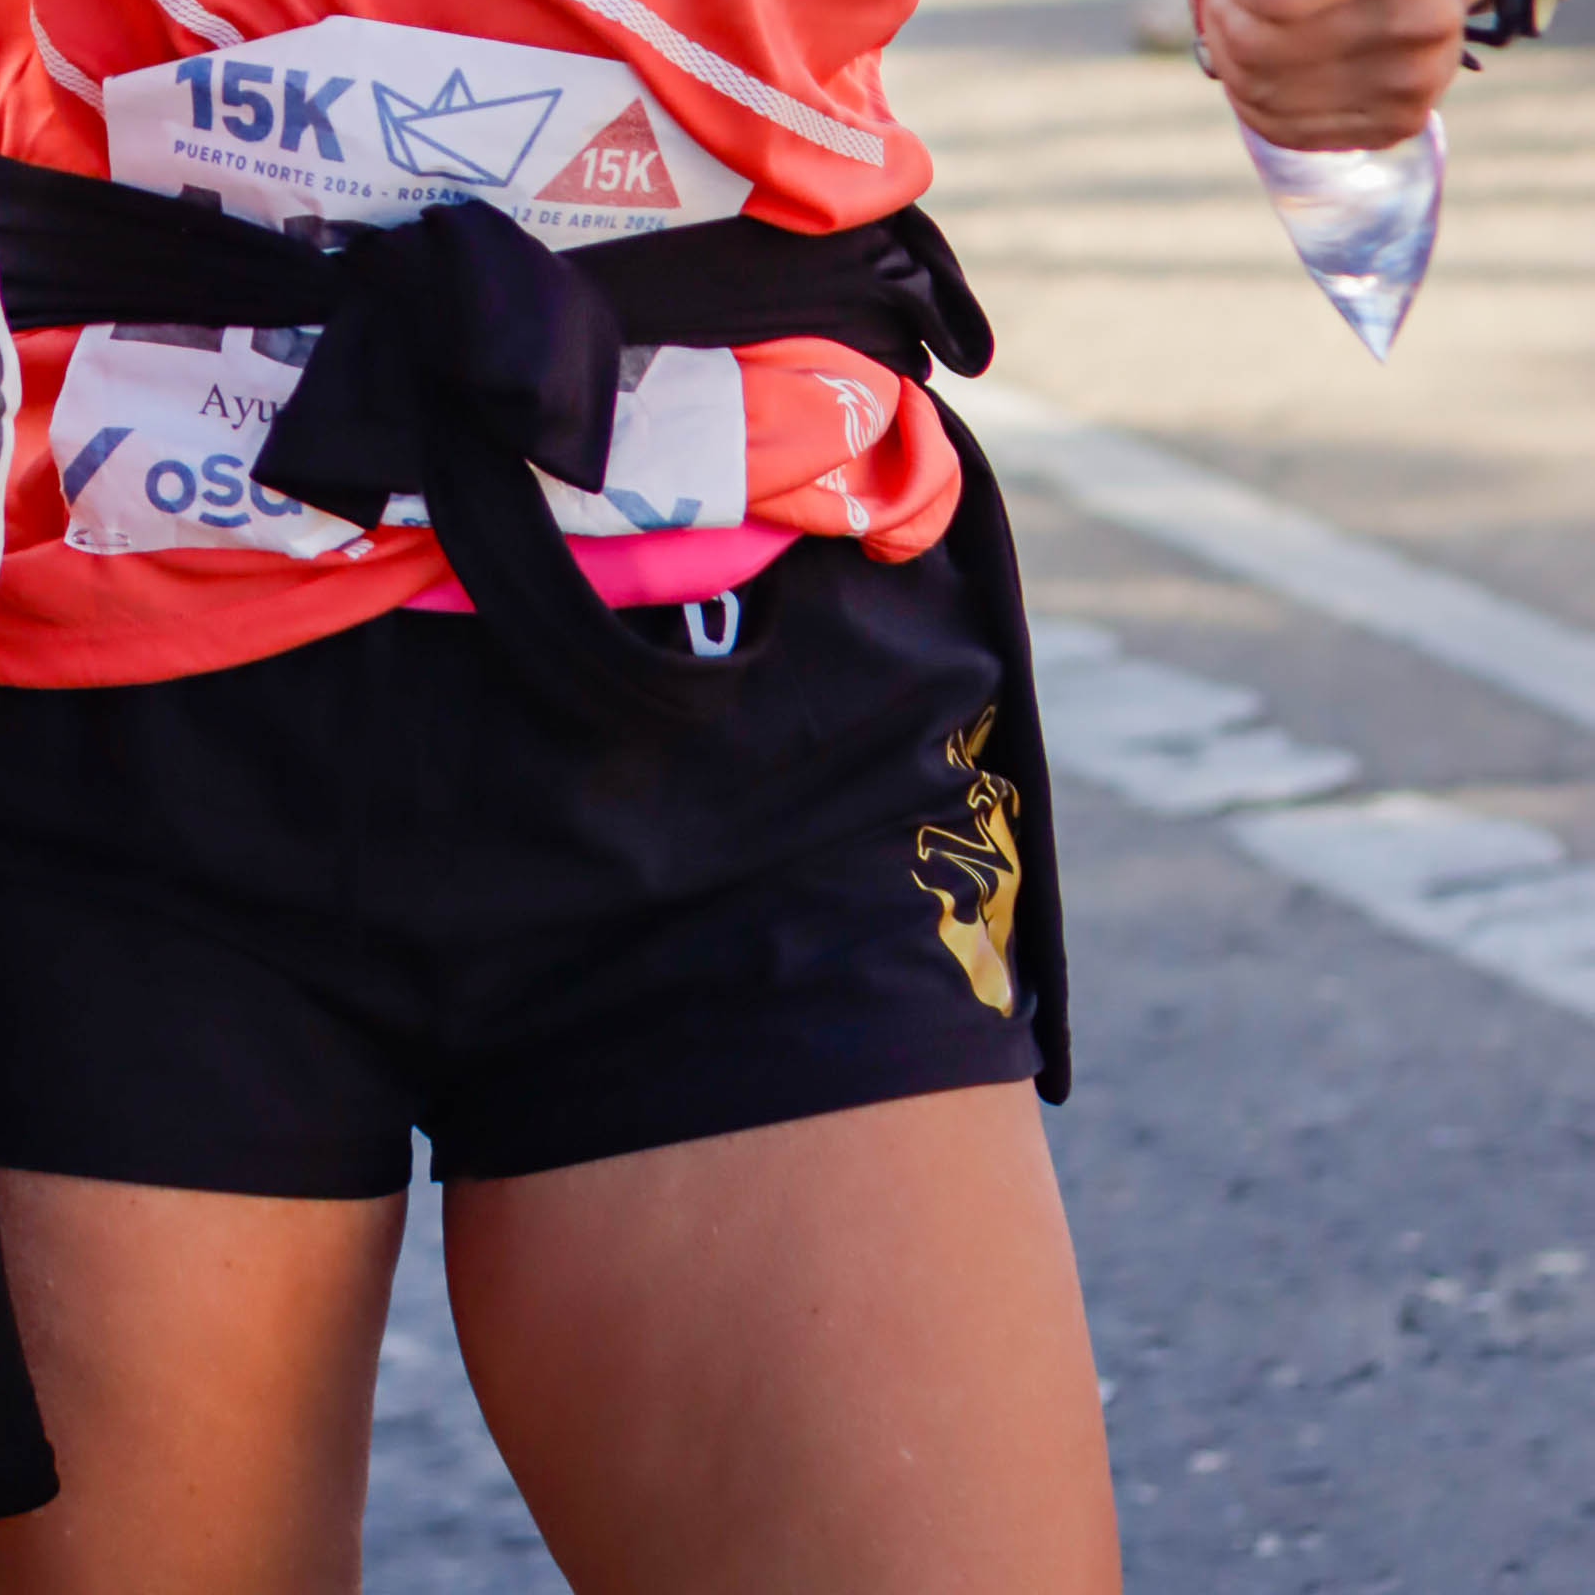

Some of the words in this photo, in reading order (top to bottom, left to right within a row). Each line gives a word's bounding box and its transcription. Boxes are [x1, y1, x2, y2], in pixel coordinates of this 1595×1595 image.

[175, 56, 356, 163] 15K
[174, 139, 246, 170] PUERTO
[254, 160, 315, 187] NORTE
[323, 177, 372, 198] 2026
[539, 210, 562, 225] DE
[568, 213, 618, 229] ABRIL
[581, 146, 660, 193] 15K
[198, 383, 286, 430] Ayu
